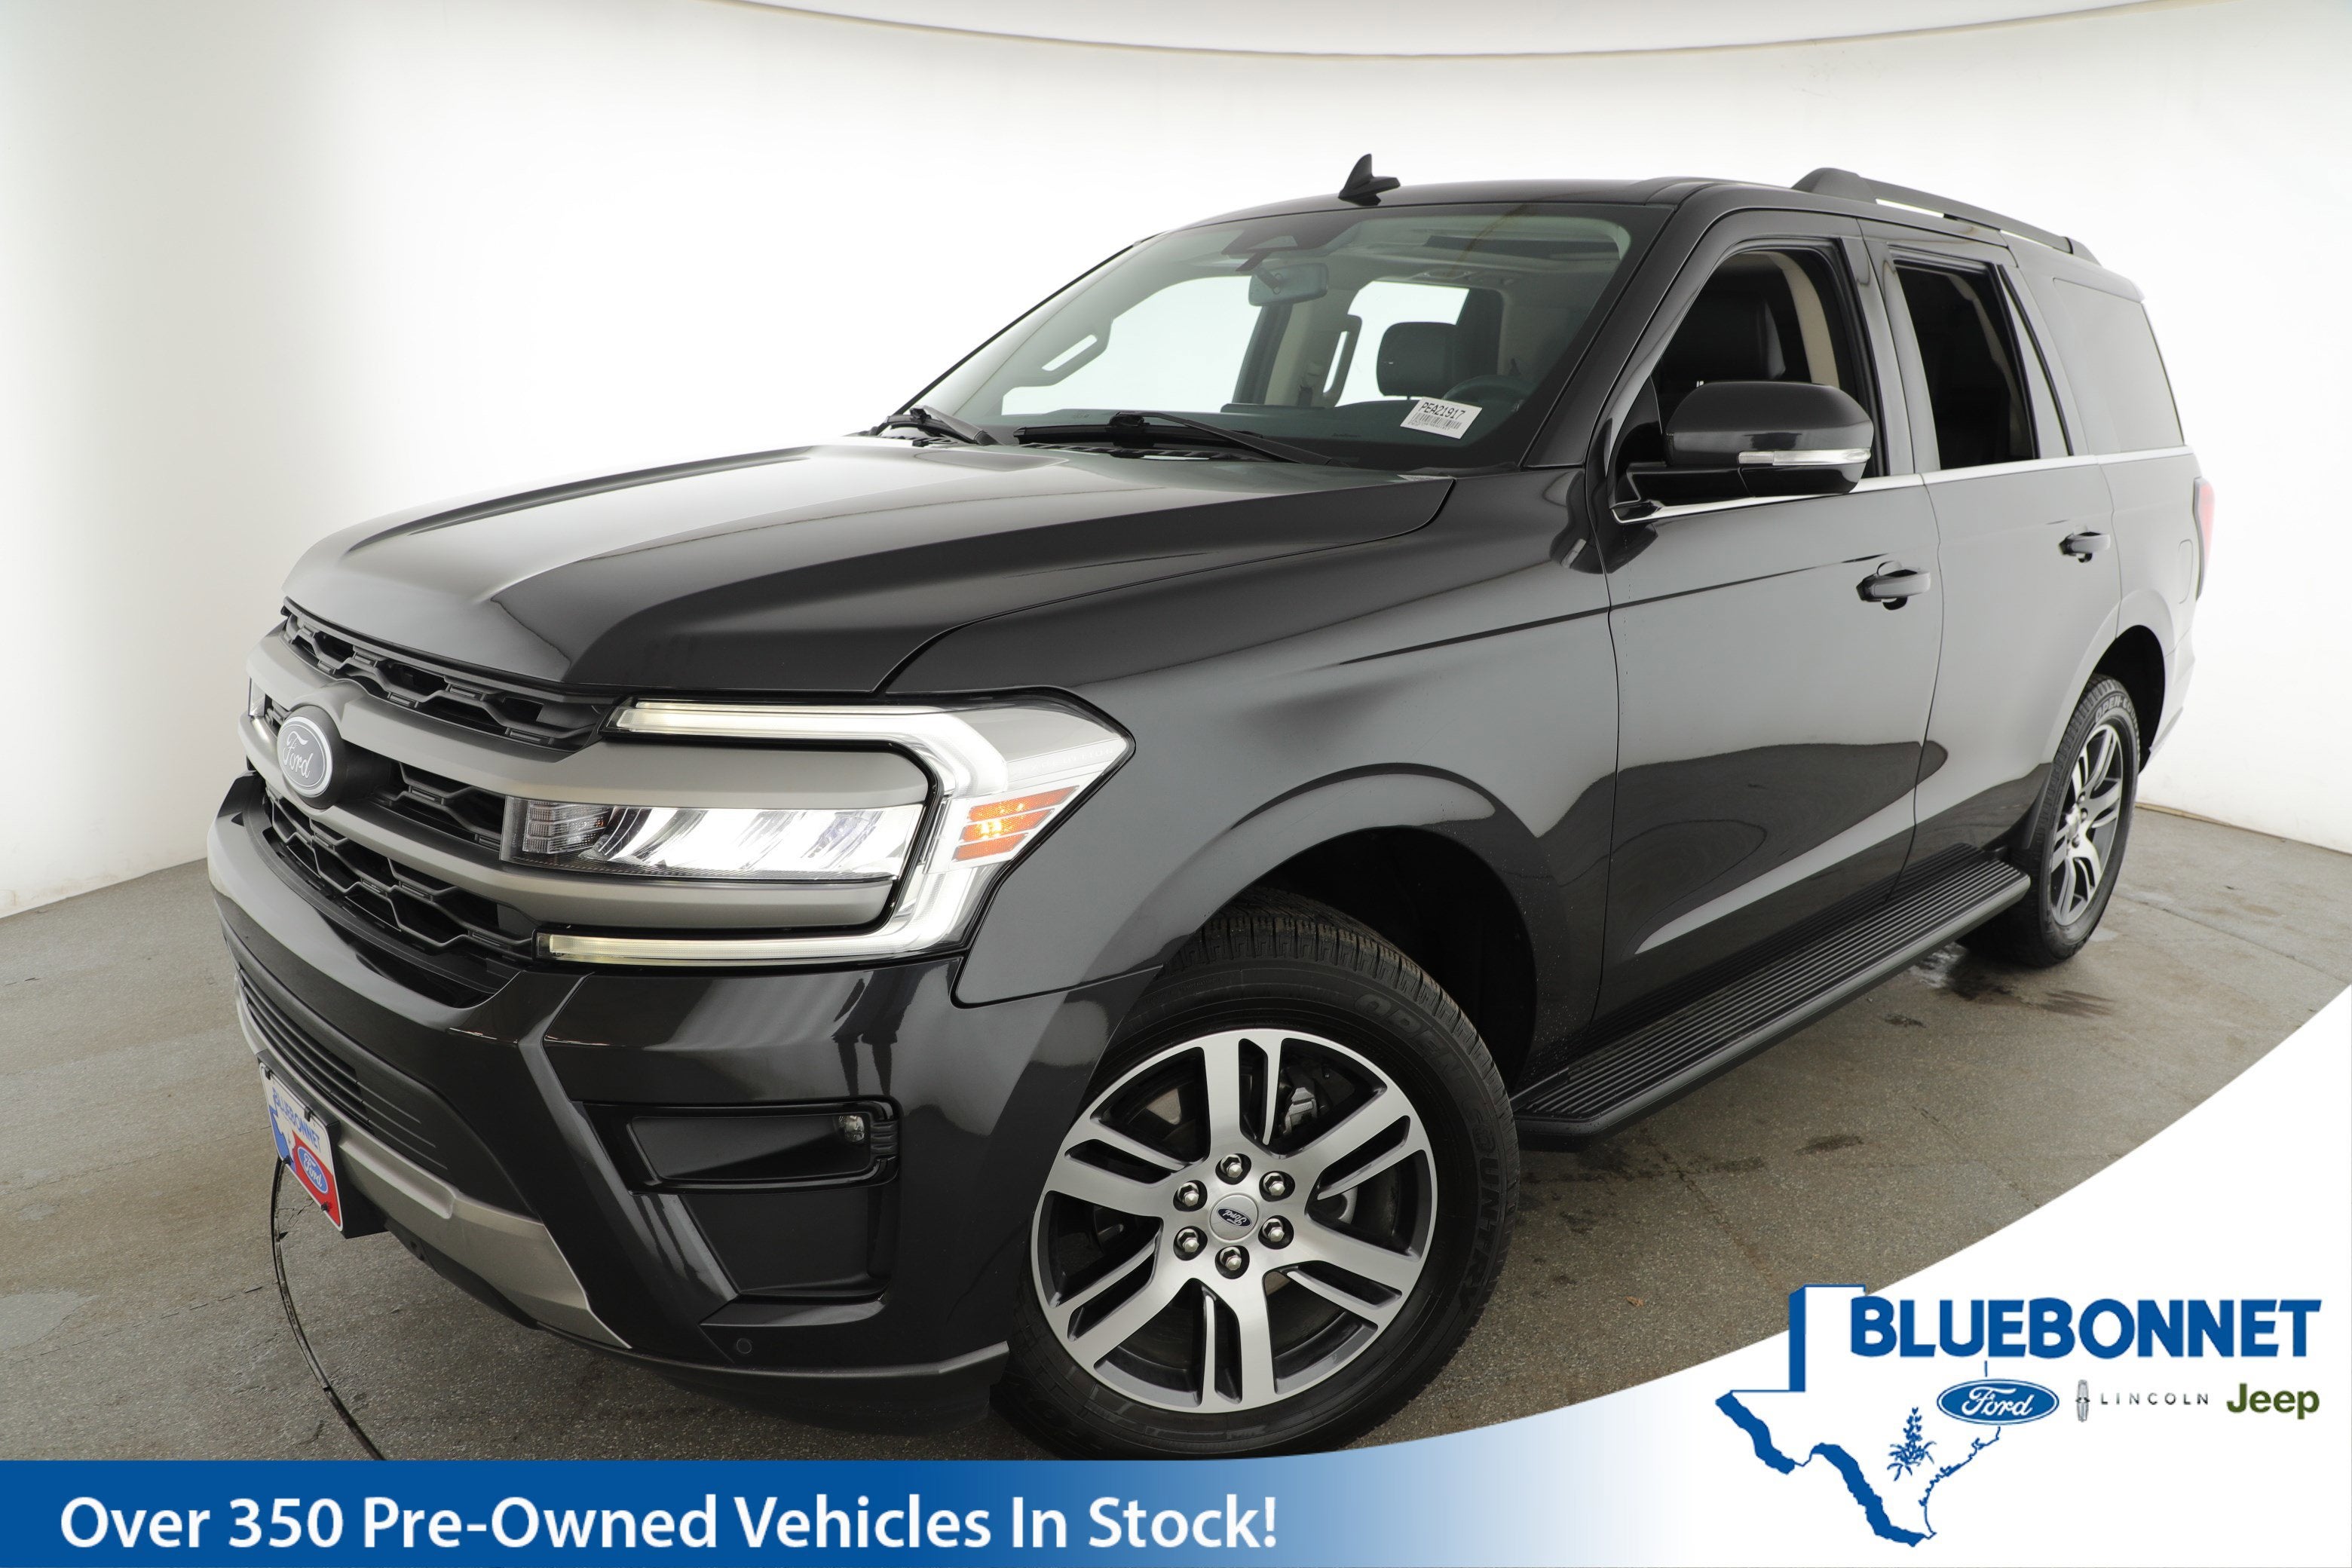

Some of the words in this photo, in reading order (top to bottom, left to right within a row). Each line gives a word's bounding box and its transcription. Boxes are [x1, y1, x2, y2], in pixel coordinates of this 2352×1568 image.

[1419, 402, 1465, 420] PEA21917
[283, 730, 314, 779] Ford
[272, 1086, 320, 1153] BLUEBONNET
[304, 1153, 323, 1188] Ford
[1223, 1209, 1248, 1226] Ford
